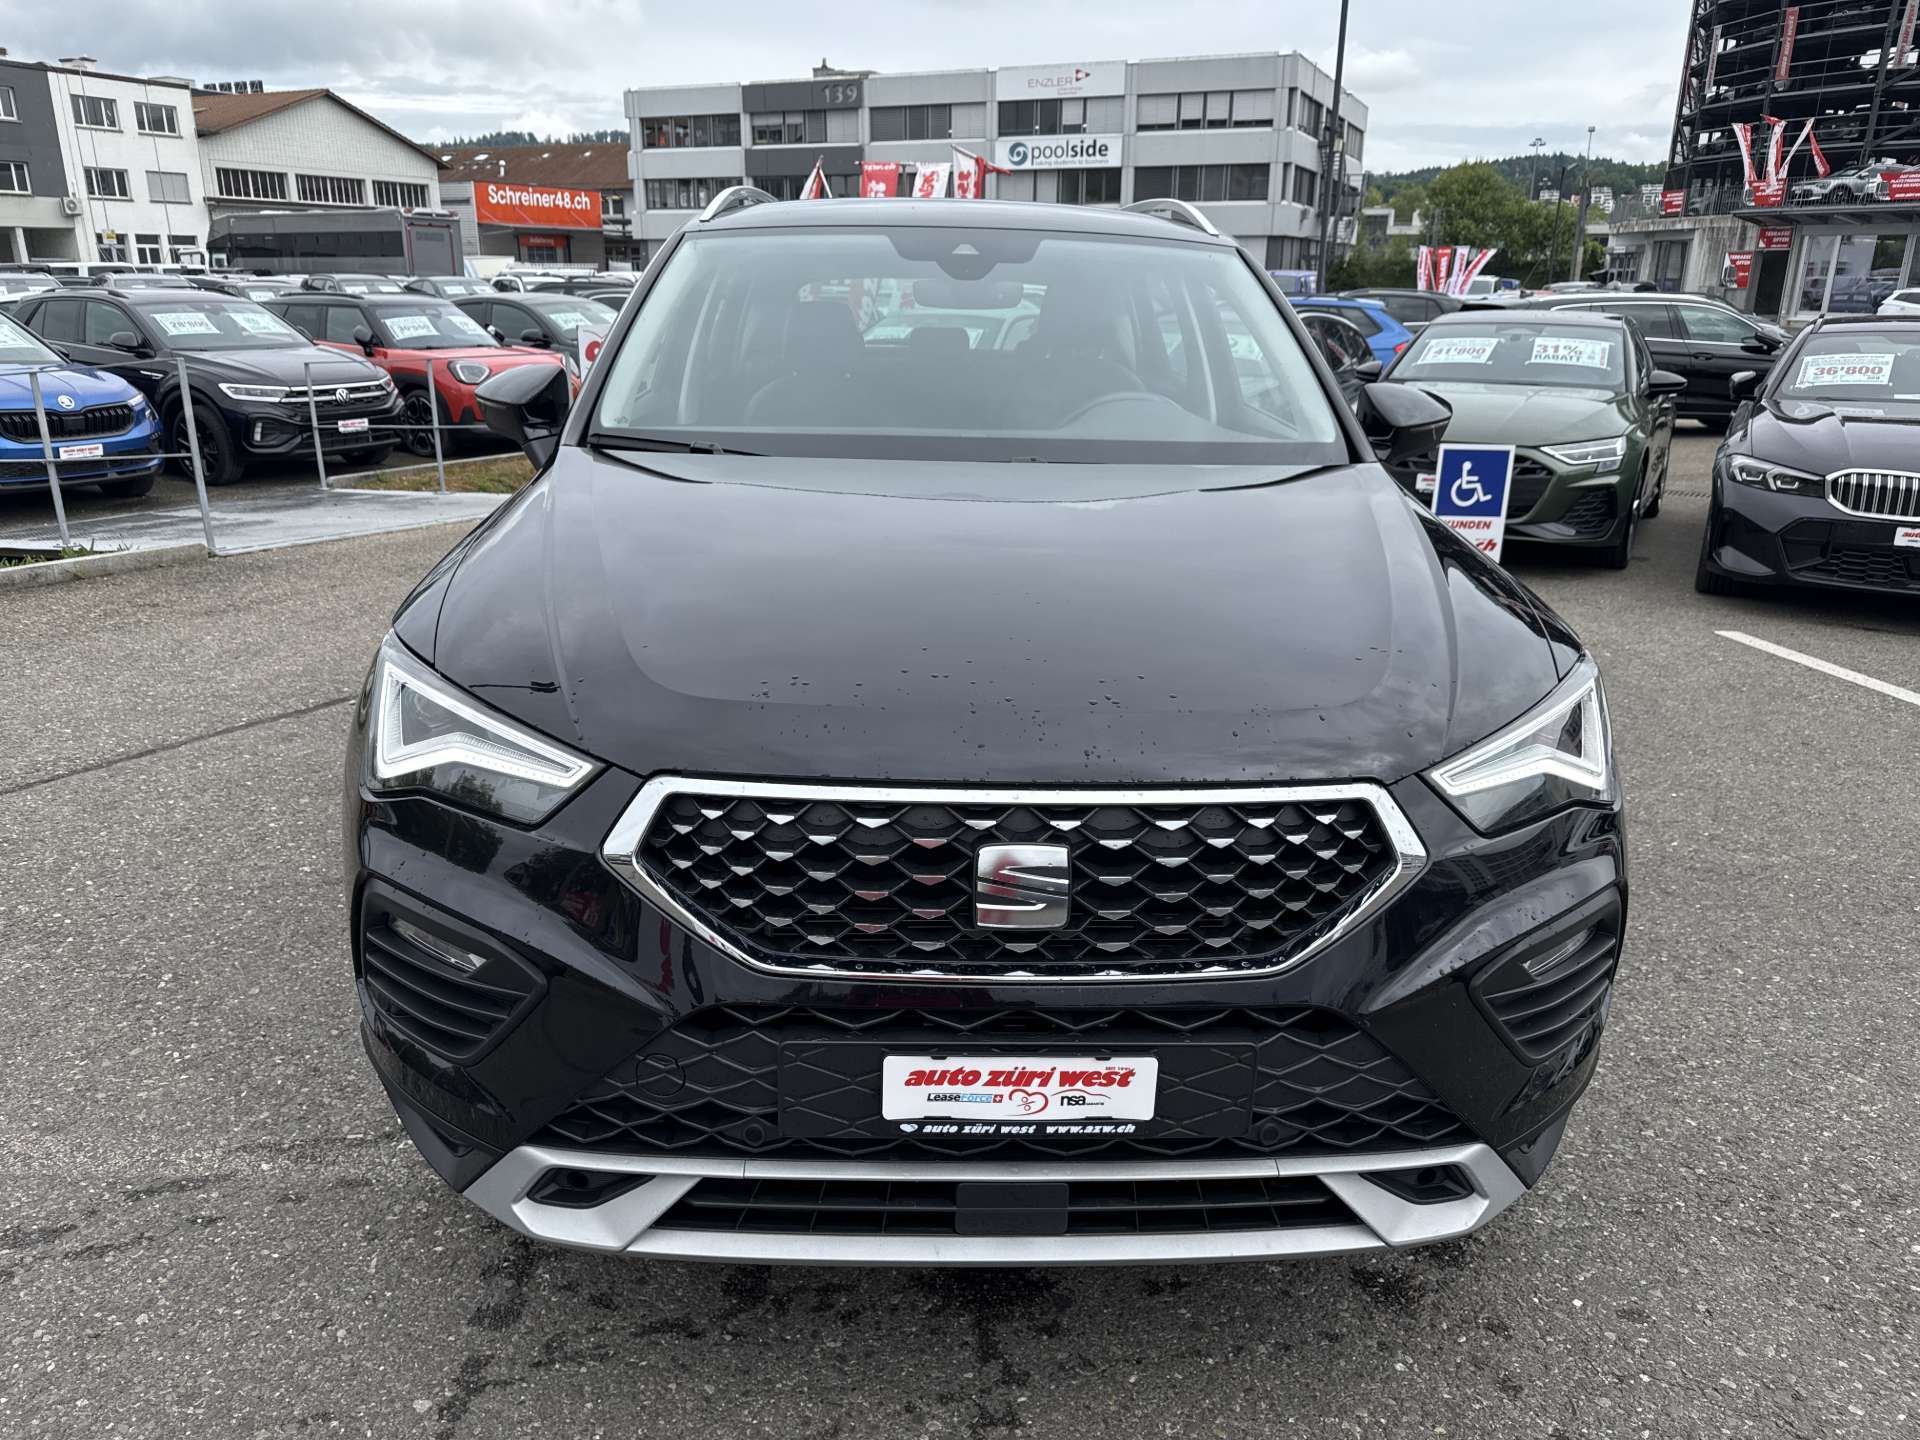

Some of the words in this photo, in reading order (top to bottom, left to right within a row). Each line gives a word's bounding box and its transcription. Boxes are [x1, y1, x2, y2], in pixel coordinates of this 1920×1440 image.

[1027, 76, 1073, 89] ENZLER
[824, 84, 858, 104] 139
[1031, 138, 1109, 166] poolside
[488, 184, 591, 211] Schreiner48.ch
[1536, 344, 1583, 356] 31%
[1534, 354, 1583, 363] RABATT
[1813, 366, 1884, 376] 36'800
[904, 1066, 981, 1088] auto
[982, 1066, 1056, 1089] züri
[1058, 1067, 1136, 1088] west
[927, 1092, 993, 1104] LeaseForce
[1060, 1094, 1087, 1107] nsa
[922, 1122, 958, 1134] auto
[961, 1122, 997, 1134] züri
[1000, 1123, 1036, 1134] west
[1045, 1122, 1136, 1134] www.azw.ch
